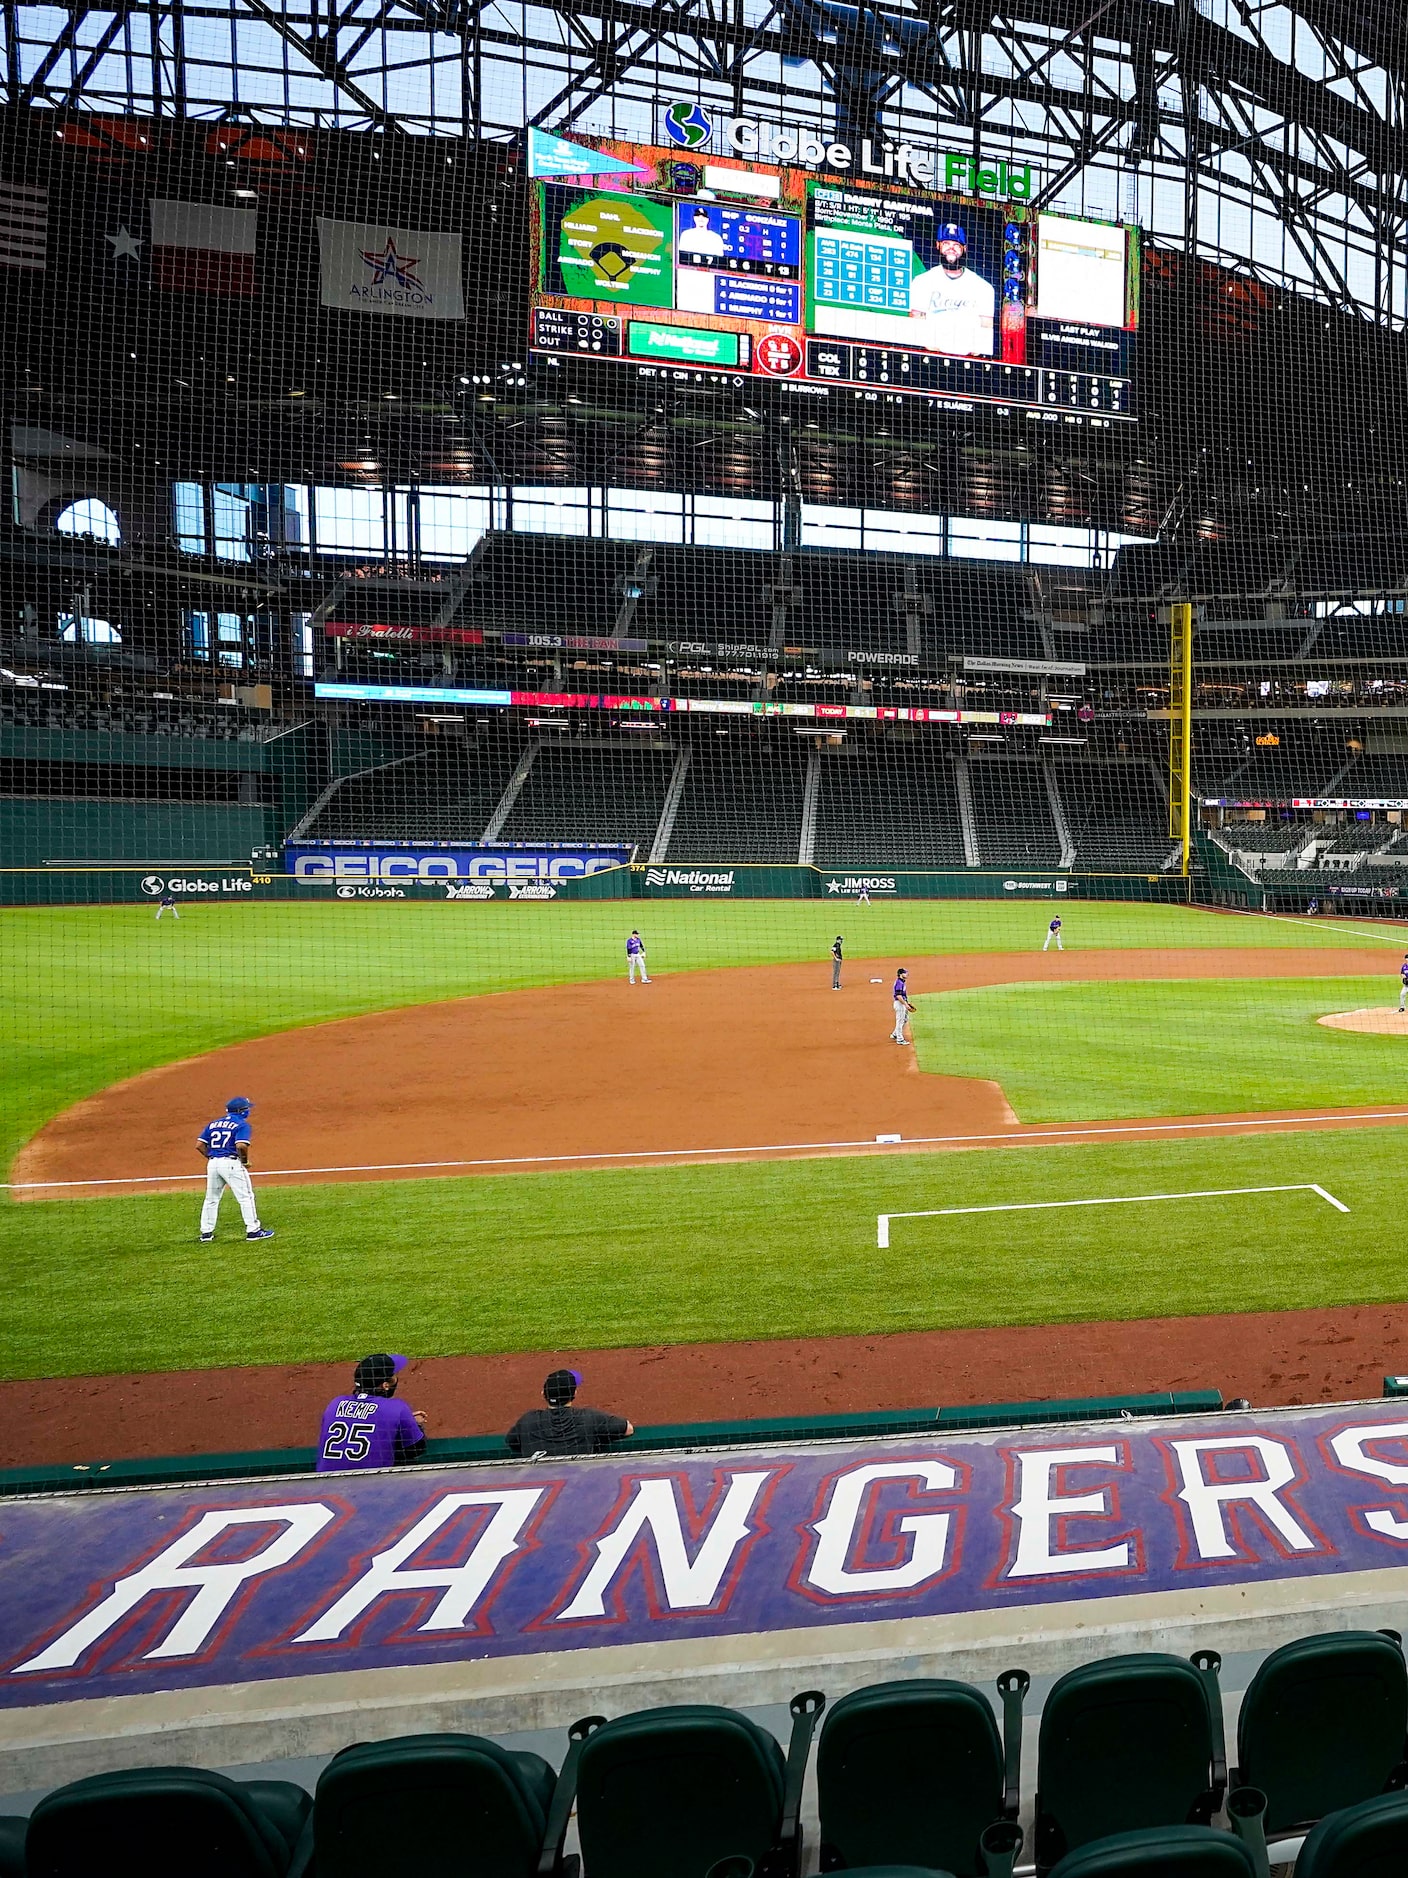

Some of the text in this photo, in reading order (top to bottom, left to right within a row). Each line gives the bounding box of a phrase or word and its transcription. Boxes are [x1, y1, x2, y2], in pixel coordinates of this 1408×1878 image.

[726, 117, 1032, 199] Globe Life Field
[729, 259, 737, 269] S
[742, 261, 750, 271] 6
[765, 264, 773, 273] T
[350, 284, 433, 304] ARLINGTON
[538, 311, 563, 322] BALL
[538, 324, 573, 335] STRIKE
[1060, 325, 1100, 337] LAST PLAY
[538, 336, 560, 346] OUT
[818, 352, 840, 364] COL
[858, 358, 867, 367] 0
[901, 363, 910, 372] 0
[818, 366, 839, 377] TEX
[858, 370, 867, 379] 0
[880, 373, 889, 382] 0
[547, 357, 560, 366] NL
[639, 368, 656, 377] DET
[673, 371, 688, 380] CIN
[788, 384, 829, 395] BURROWS
[928, 399, 934, 407] 7
[943, 401, 973, 411] SUÁREZ
[356, 624, 414, 640] Fratelli
[528, 635, 561, 647] 105.3
[679, 642, 711, 654] PGL
[848, 651, 919, 666] POWERADE
[175, 664, 249, 679] PLUCKERS
[821, 707, 844, 716] TODAY
[294, 855, 622, 886] GEICO GEICO
[665, 870, 732, 885] National
[167, 878, 252, 892] Globe Life
[358, 886, 405, 898] Kubota
[458, 886, 487, 894] ARROW
[521, 886, 550, 894] ARROW
[689, 884, 731, 892] Car Rental
[210, 1131, 232, 1149] 27
[335, 1400, 379, 1420] KEMP
[323, 1421, 376, 1461] 25
